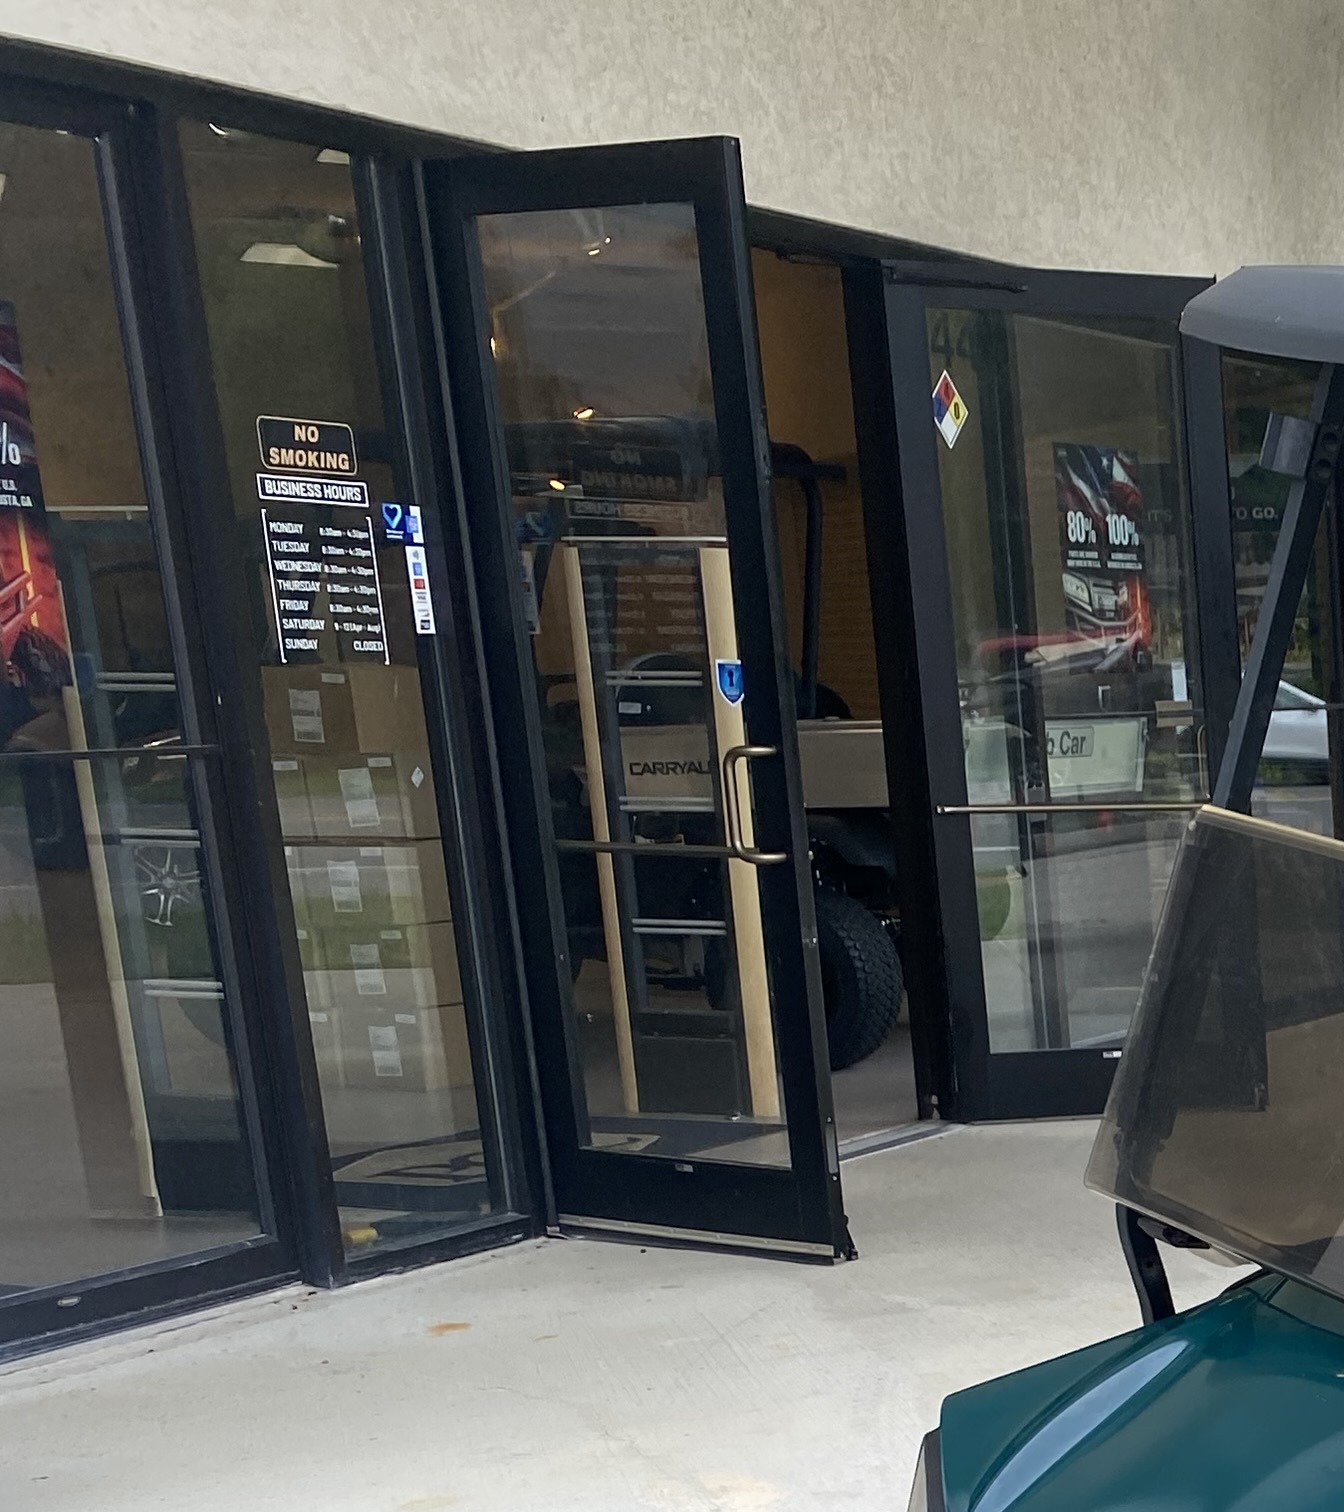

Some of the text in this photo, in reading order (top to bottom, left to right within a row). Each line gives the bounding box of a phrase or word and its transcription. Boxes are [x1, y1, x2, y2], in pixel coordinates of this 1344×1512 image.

[294, 424, 319, 442] NO
[269, 446, 349, 470] SMOKING
[264, 479, 361, 501] BUSINESS HOURS
[269, 521, 304, 534] MONDAY
[1066, 510, 1139, 546] 80% 100%
[271, 540, 309, 553] TUESDAY
[273, 560, 321, 573] WEDNESDAY
[276, 579, 320, 592] THURSDAY
[280, 599, 309, 611] FRIDAY
[282, 618, 325, 631] SATURDAY
[284, 638, 384, 652] SUNDAY CLOSED
[1059, 730, 1087, 756] Car
[629, 760, 711, 776] CARRYAL
